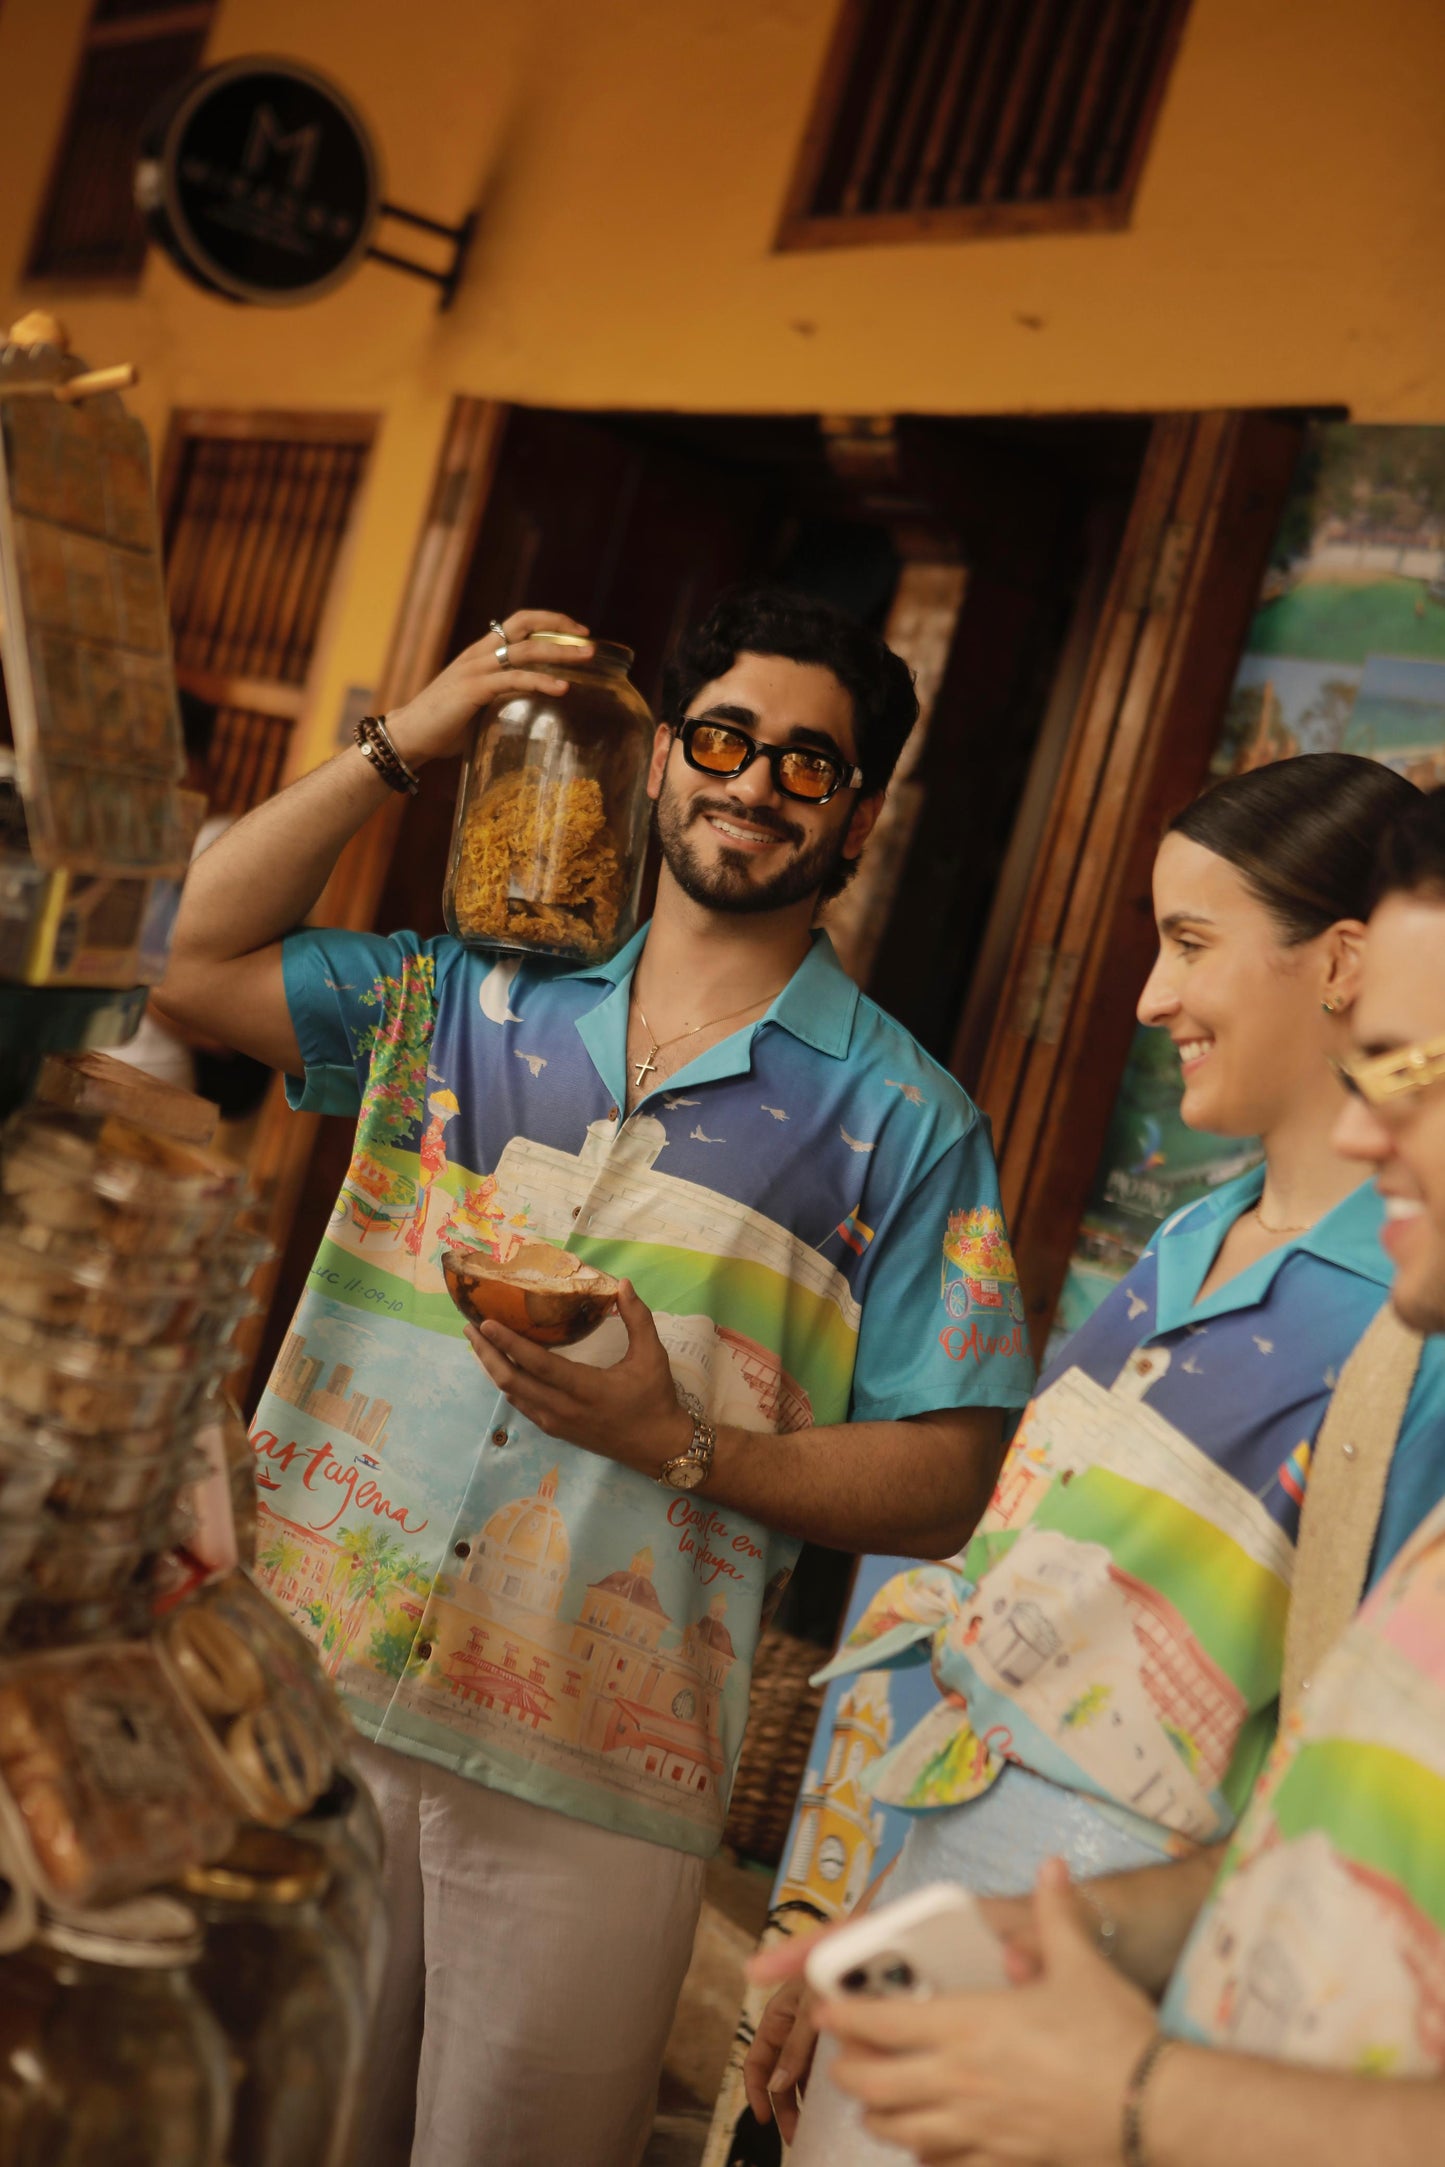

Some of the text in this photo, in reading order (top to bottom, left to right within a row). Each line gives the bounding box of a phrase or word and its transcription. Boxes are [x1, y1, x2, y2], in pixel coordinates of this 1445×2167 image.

[242, 101, 322, 192] M
[247, 1412, 428, 1534] artagena
[678, 1528, 695, 1554] la
[731, 1535, 763, 1560] en
